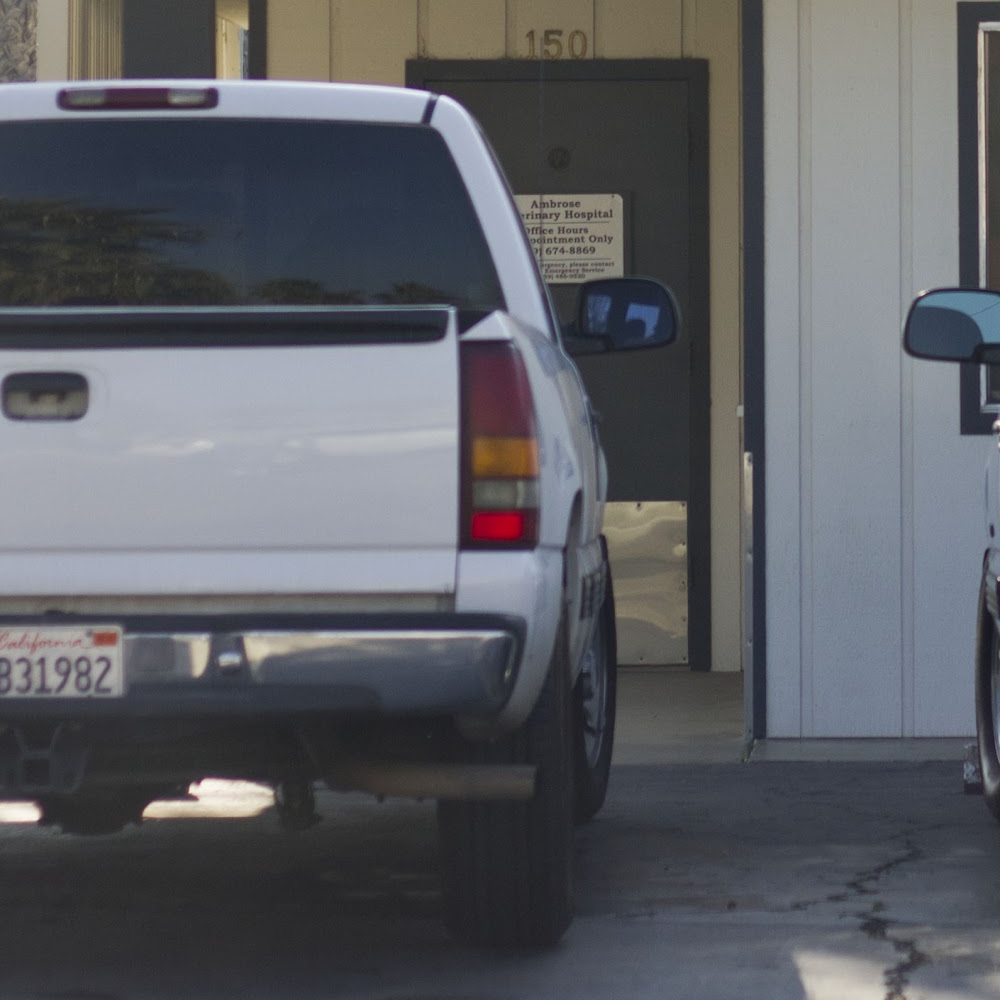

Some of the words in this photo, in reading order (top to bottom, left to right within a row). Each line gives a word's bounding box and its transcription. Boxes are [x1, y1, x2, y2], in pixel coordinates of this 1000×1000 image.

[526, 29, 588, 60] 150
[530, 200, 581, 209] Ambrose
[564, 209, 613, 220] Hospital
[557, 226, 589, 235] Hours
[588, 235, 613, 244] Only
[545, 246, 596, 255] 674-8869
